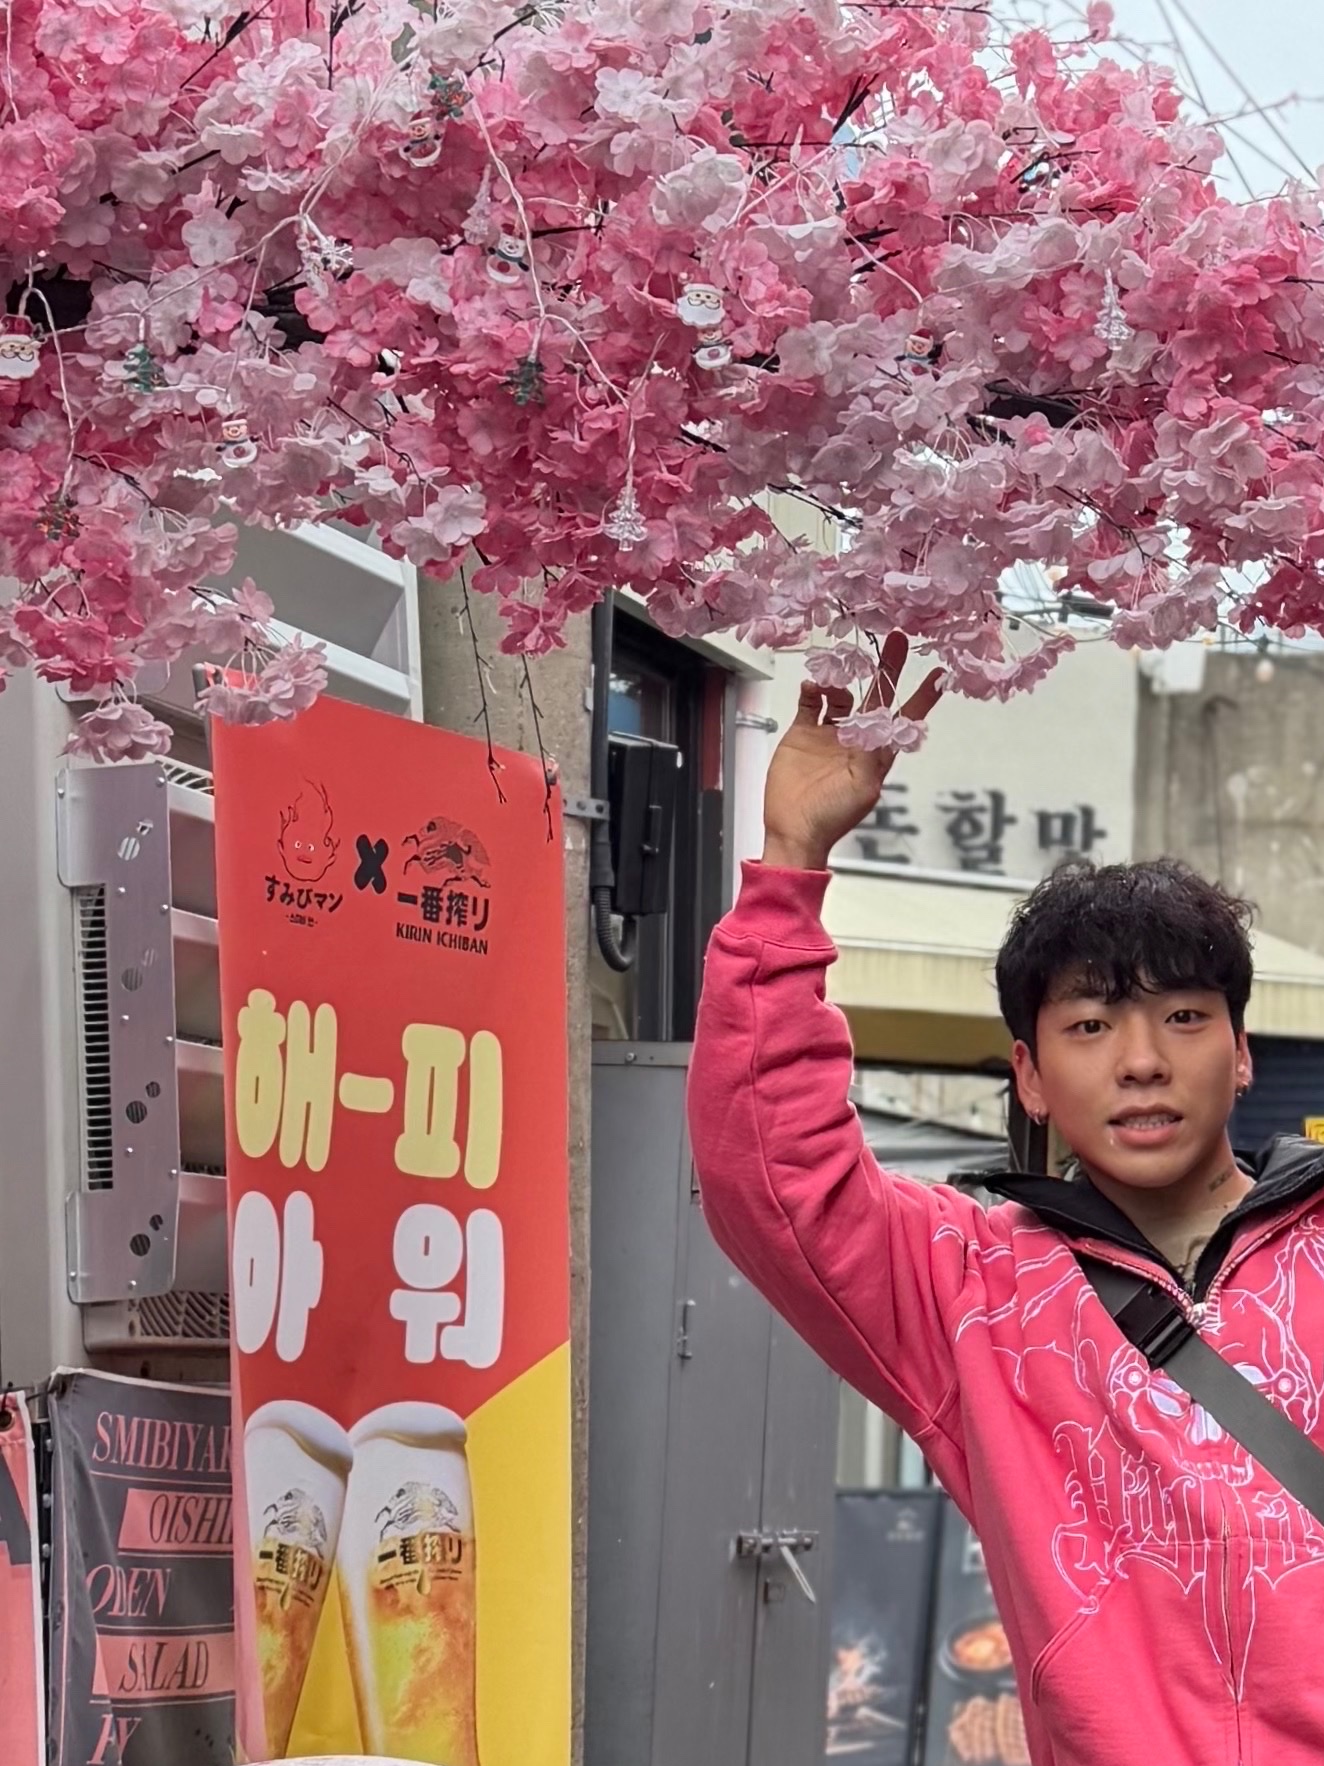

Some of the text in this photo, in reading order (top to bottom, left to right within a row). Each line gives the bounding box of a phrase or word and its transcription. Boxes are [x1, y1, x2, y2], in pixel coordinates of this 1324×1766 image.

[264, 875, 344, 914] すみびマン
[397, 885, 490, 932] 一番搾り
[396, 922, 489, 955] KIRIN ICHIBAN
[118, 1640, 210, 1692] SALAD
